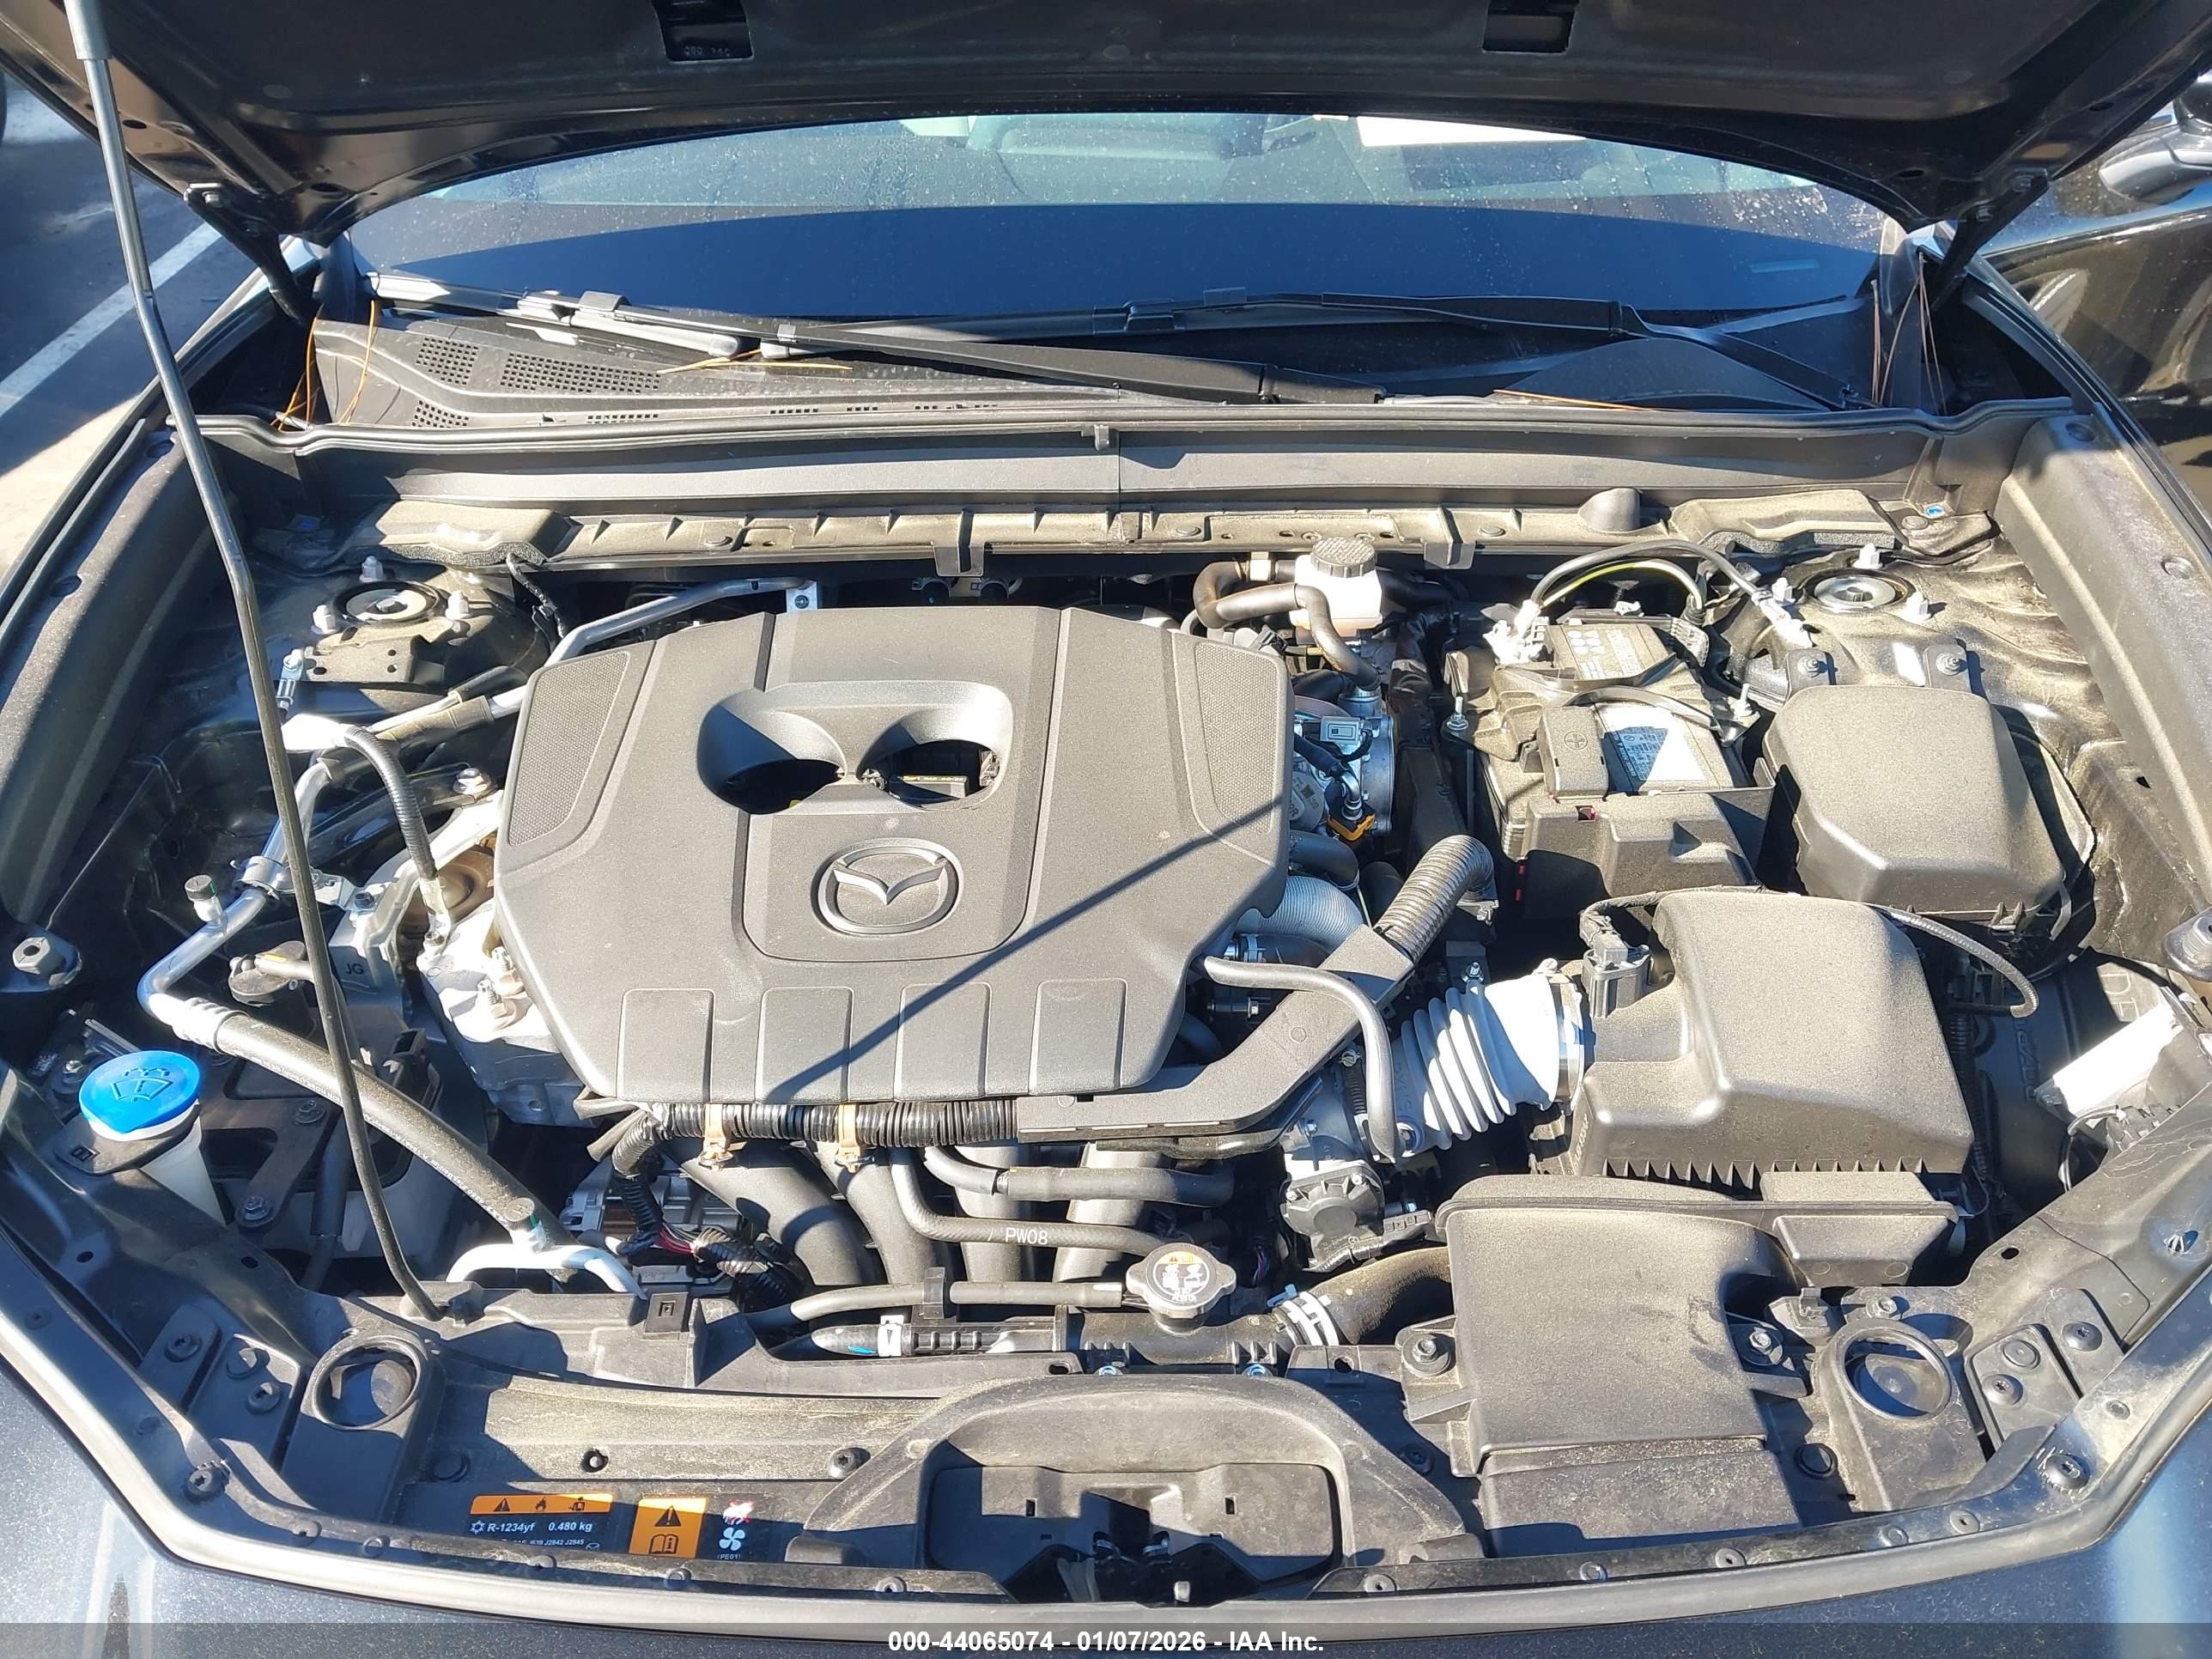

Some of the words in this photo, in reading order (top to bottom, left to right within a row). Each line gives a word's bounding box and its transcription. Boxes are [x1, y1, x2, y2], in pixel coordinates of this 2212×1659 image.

[345, 963, 364, 975] JG
[1005, 1227, 1048, 1245] PW08
[487, 1522, 537, 1534] R-1234yf
[548, 1522, 576, 1532] 0.480
[579, 1522, 592, 1533] kg
